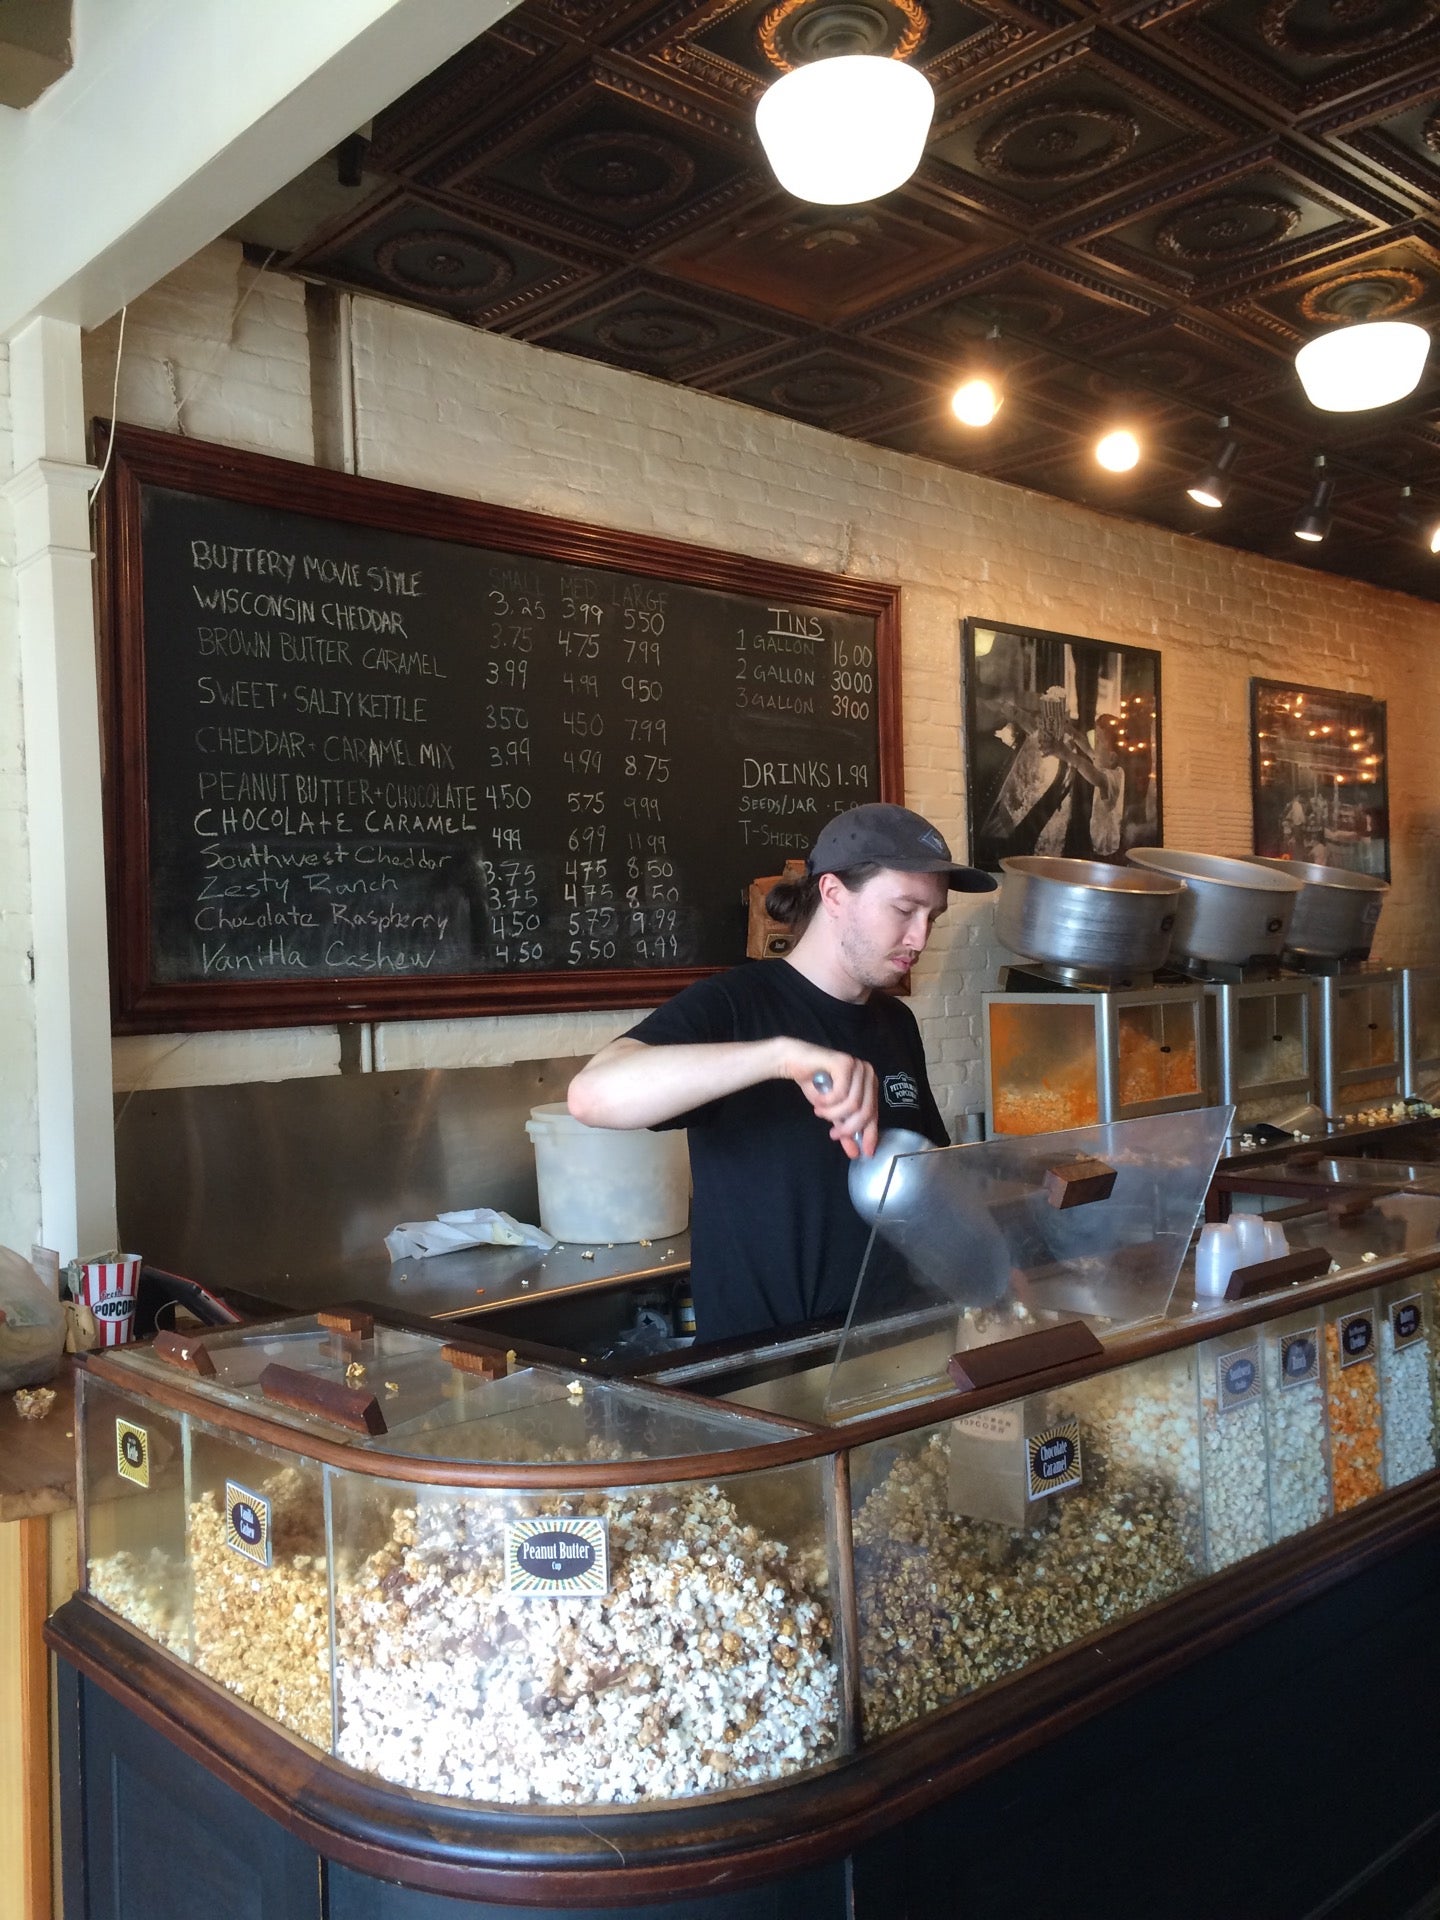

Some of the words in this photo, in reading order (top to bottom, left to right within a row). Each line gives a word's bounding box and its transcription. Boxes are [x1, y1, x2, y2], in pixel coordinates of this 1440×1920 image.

[191, 540, 296, 584] BUTTERY
[303, 554, 362, 588] MOVIE
[367, 566, 427, 598] STYLE
[193, 584, 315, 624] WISCONSIN
[322, 602, 408, 639] CHEDDAR
[488, 591, 546, 620] 3.25
[767, 607, 824, 639] TINS
[198, 627, 271, 659] BROWN
[279, 631, 352, 666] BUTTER
[362, 647, 448, 679] CARAMEL
[489, 622, 534, 653] 3.75
[558, 629, 601, 659] 4.75
[753, 634, 815, 656] GALLON
[735, 657, 747, 680] 2
[753, 665, 815, 687] GALLON
[197, 676, 279, 710] SWEET
[293, 685, 353, 717] SALTY
[358, 693, 428, 723] KETTLE
[752, 692, 814, 715] GALLON
[624, 718, 667, 746] 7.99
[194, 726, 307, 759] CHEDDAR
[323, 735, 417, 769] CARAMEL
[420, 742, 458, 770] MIX
[488, 737, 531, 767] 3.99
[624, 754, 672, 784] 8.75
[199, 771, 291, 802] PEANUT
[742, 758, 831, 788] DRINKS
[837, 763, 868, 788] 1.99
[194, 806, 353, 837] CHOCOLATE
[364, 809, 477, 835] CARAMEL
[738, 819, 810, 849] T-SHIRTS
[200, 842, 351, 870] Southwest
[354, 845, 453, 871] Cheddar
[197, 871, 290, 903] Zesty
[301, 873, 400, 899] Ranch
[194, 901, 320, 932] Chocolate
[329, 901, 450, 941] Raspberry
[202, 935, 309, 975] Vanilla
[323, 939, 437, 973] Cashew
[523, 1541, 557, 1560] Peanut
[559, 1541, 590, 1560] Butter
[551, 1561, 562, 1572] Cup
